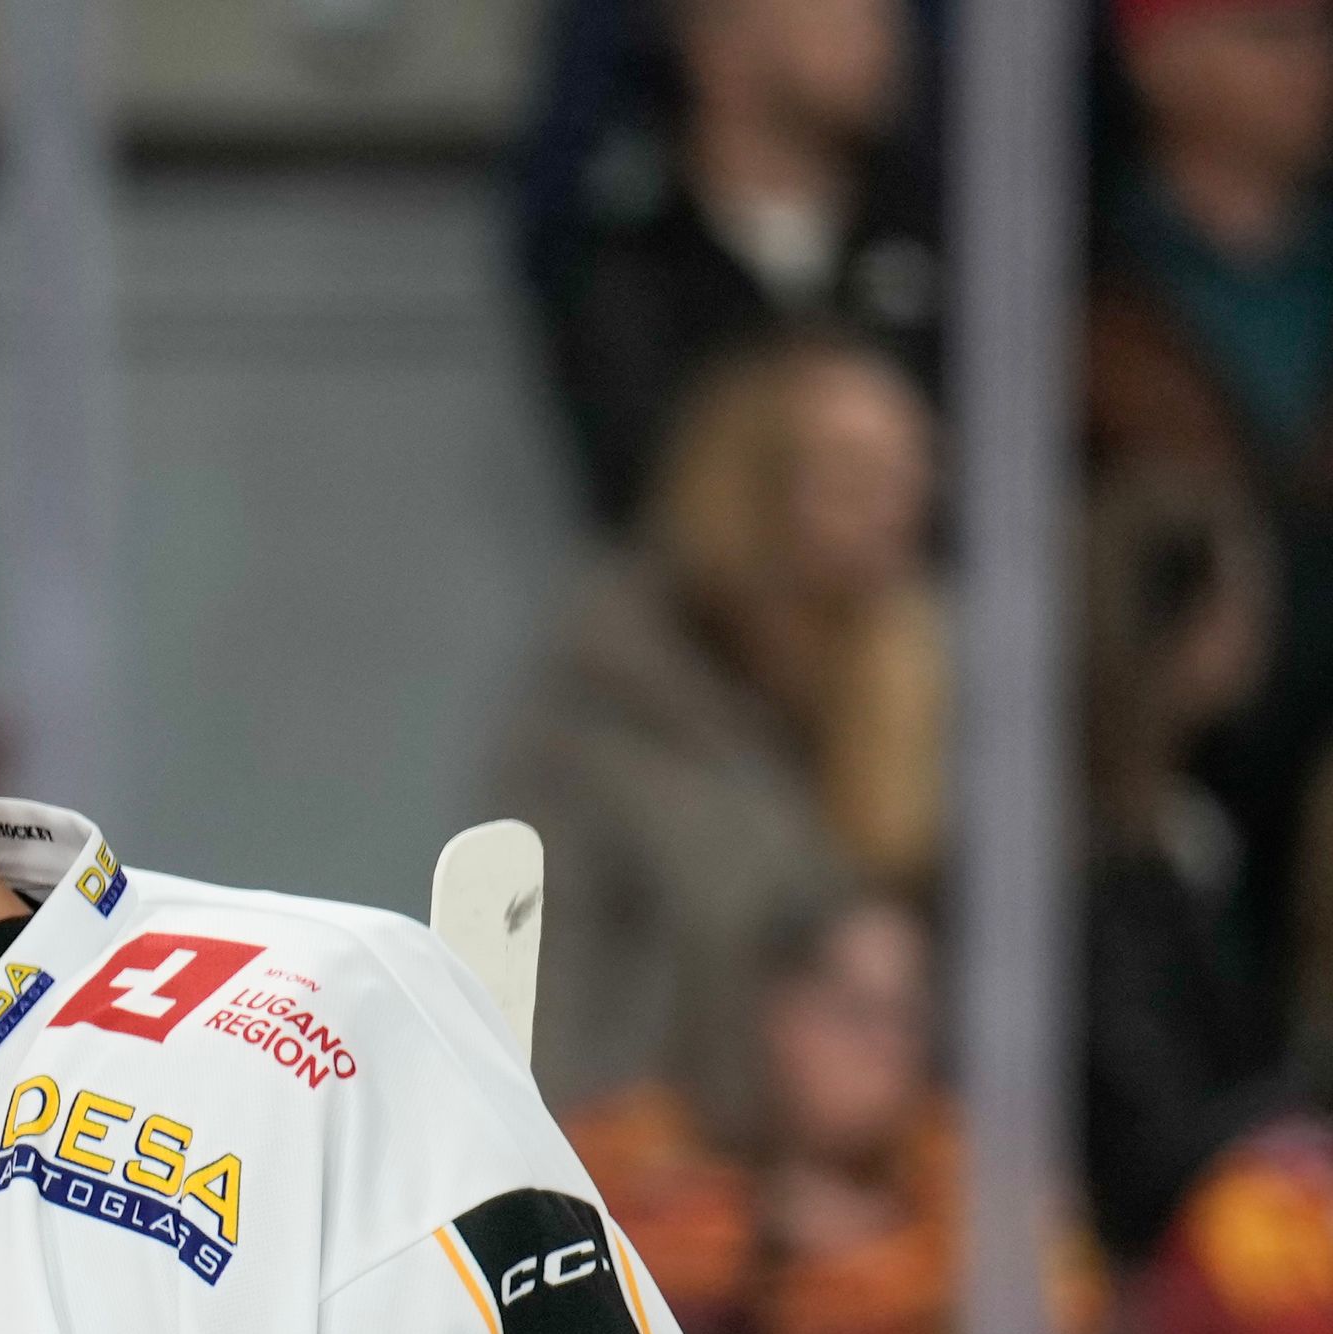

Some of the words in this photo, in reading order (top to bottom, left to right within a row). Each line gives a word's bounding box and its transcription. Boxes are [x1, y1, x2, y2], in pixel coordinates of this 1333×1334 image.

[204, 1010, 331, 1090] REGION
[229, 987, 357, 1080] LUGANO
[0, 1073, 242, 1247] DESA
[500, 1239, 612, 1308] CC
